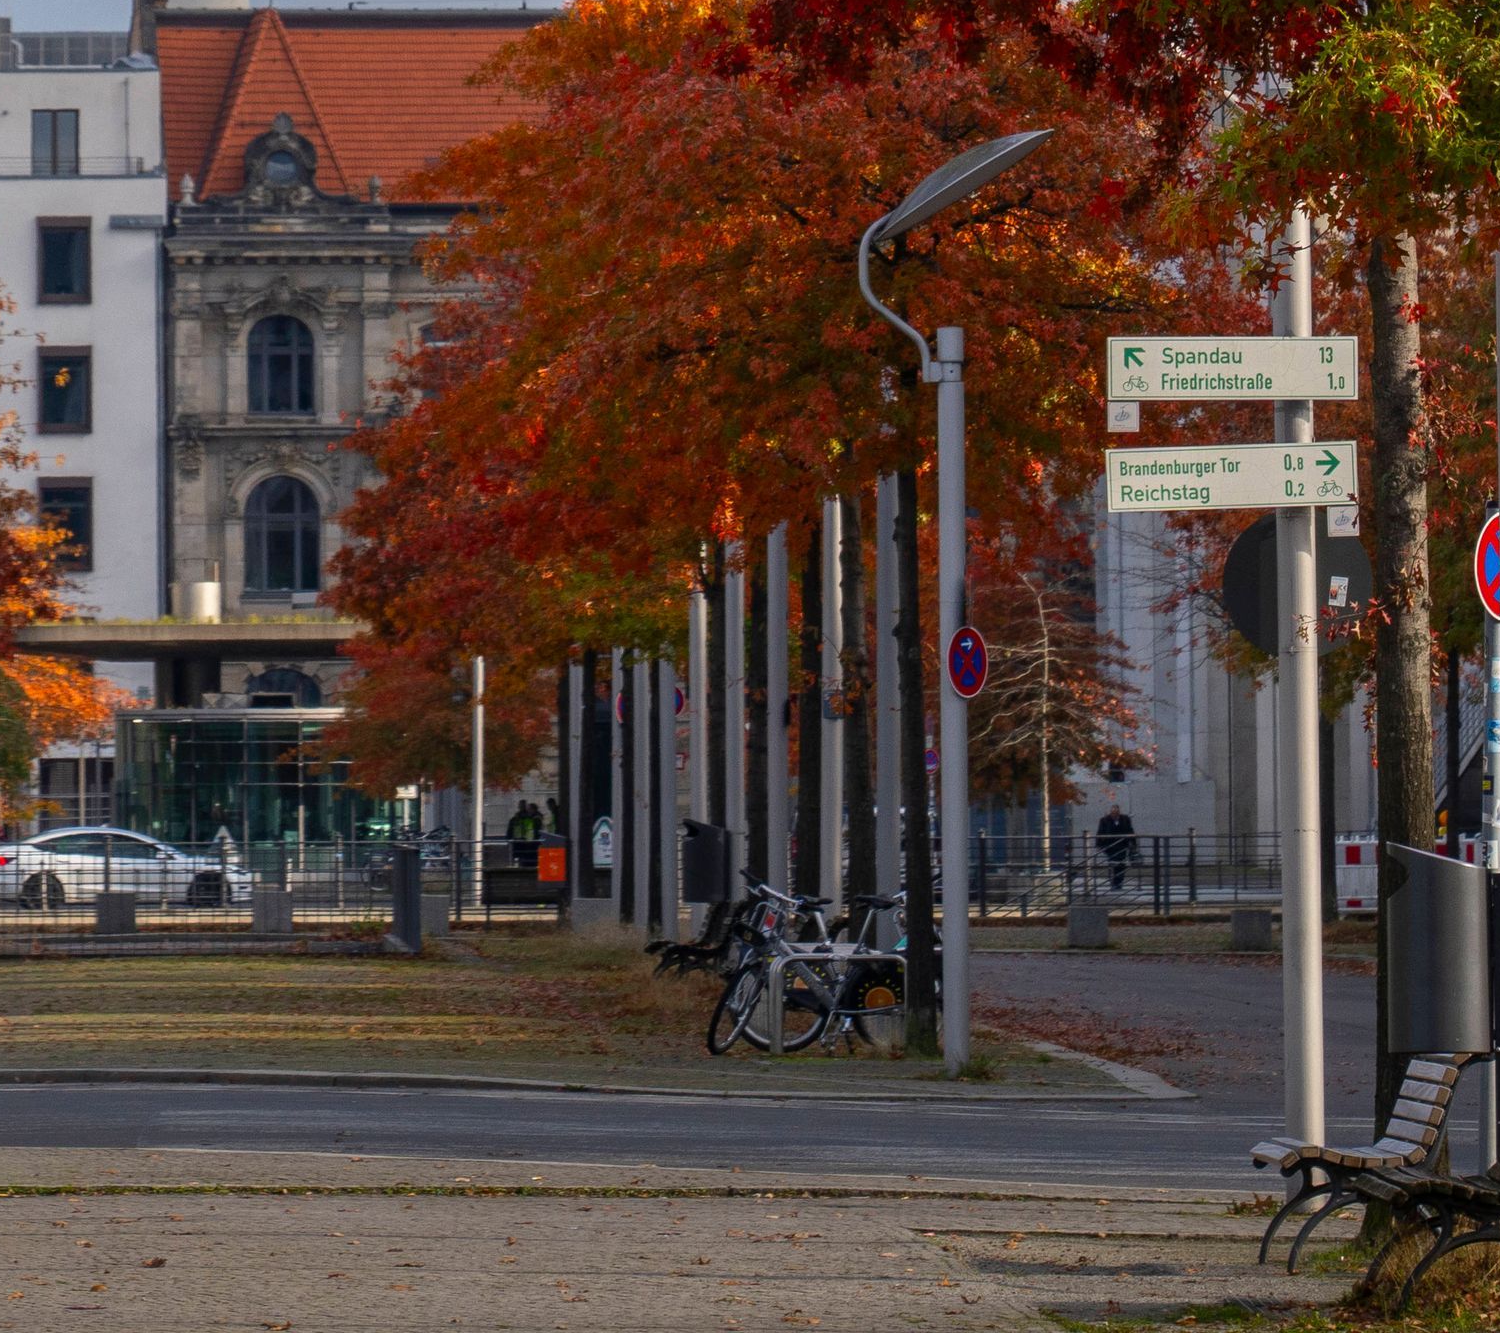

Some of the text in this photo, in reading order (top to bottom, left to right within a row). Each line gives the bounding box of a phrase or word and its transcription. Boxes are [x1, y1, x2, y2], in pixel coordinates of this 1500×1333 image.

[1162, 347, 1333, 369] Spandau 13
[1161, 373, 1345, 390] Friedrichstraße 1,0
[1119, 454, 1304, 477] Brandenburger Tor 0,8
[1121, 480, 1305, 504] Reichstag 0,2
